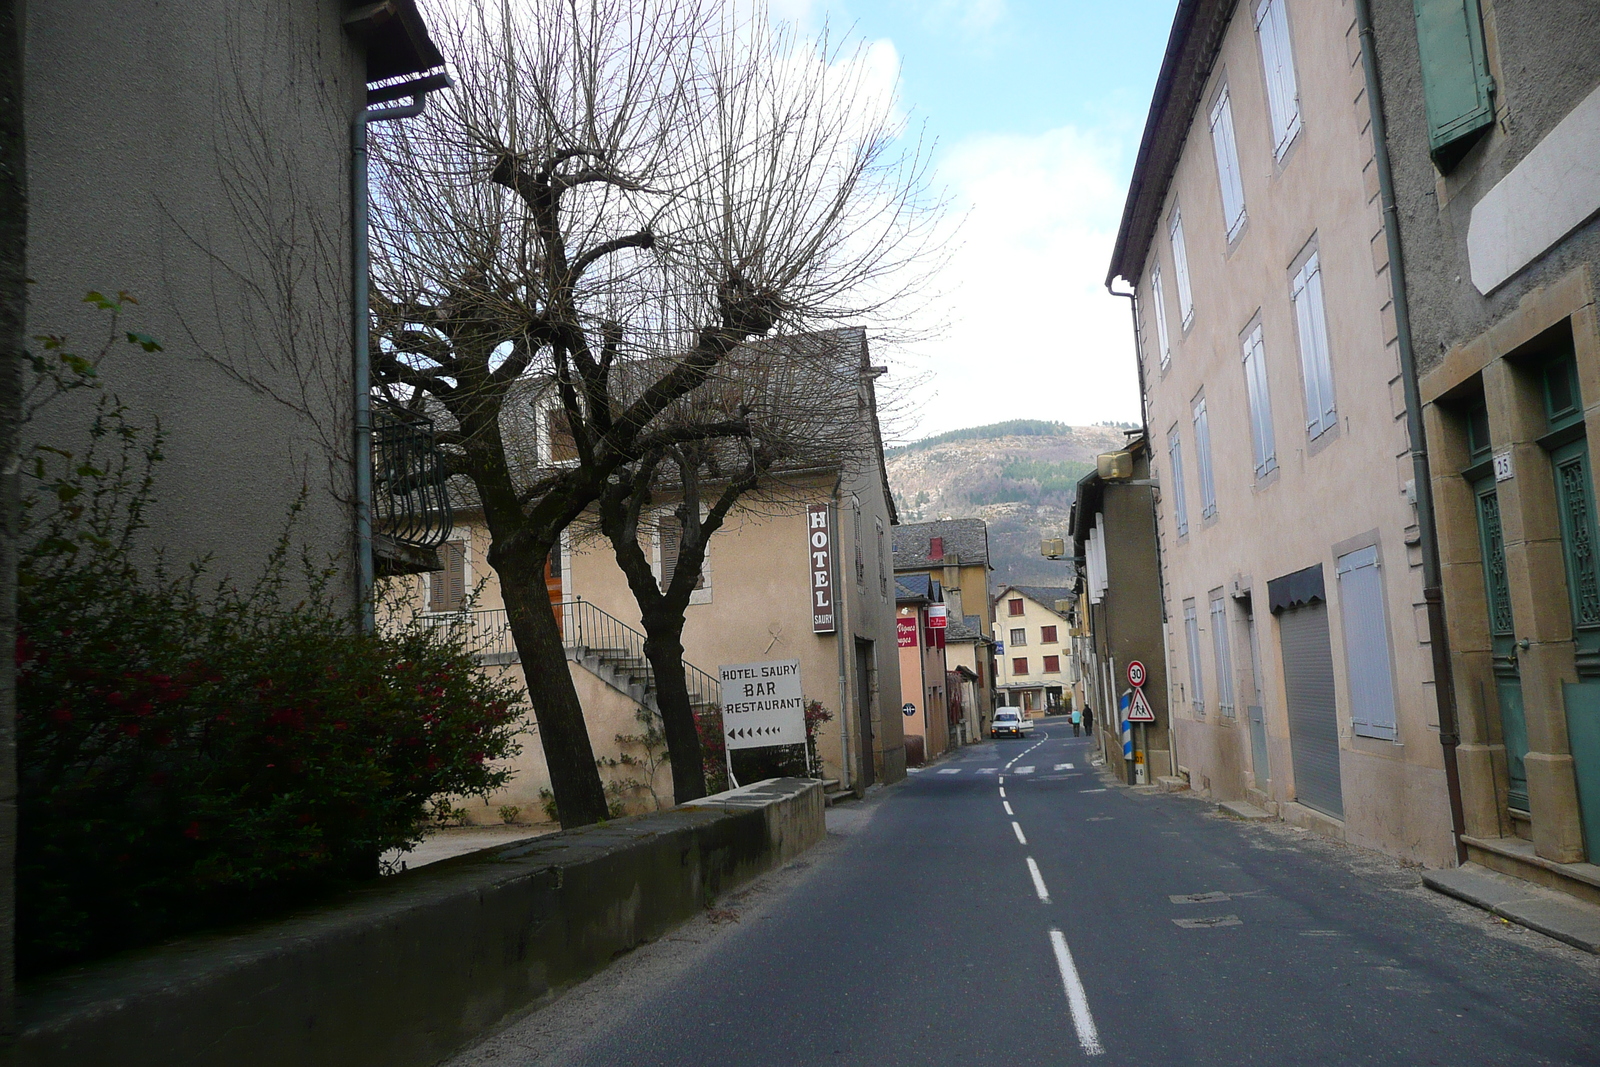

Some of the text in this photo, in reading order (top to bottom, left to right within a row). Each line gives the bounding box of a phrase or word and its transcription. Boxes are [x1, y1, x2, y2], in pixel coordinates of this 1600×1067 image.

[1498, 458, 1508, 475] 25
[810, 511, 829, 607] HOTEL
[814, 614, 833, 624] SAURY
[722, 664, 797, 680] HOTEL SAURY
[1132, 669, 1141, 679] 30
[743, 681, 776, 697] BAR
[724, 697, 802, 714] RESTAURANT
